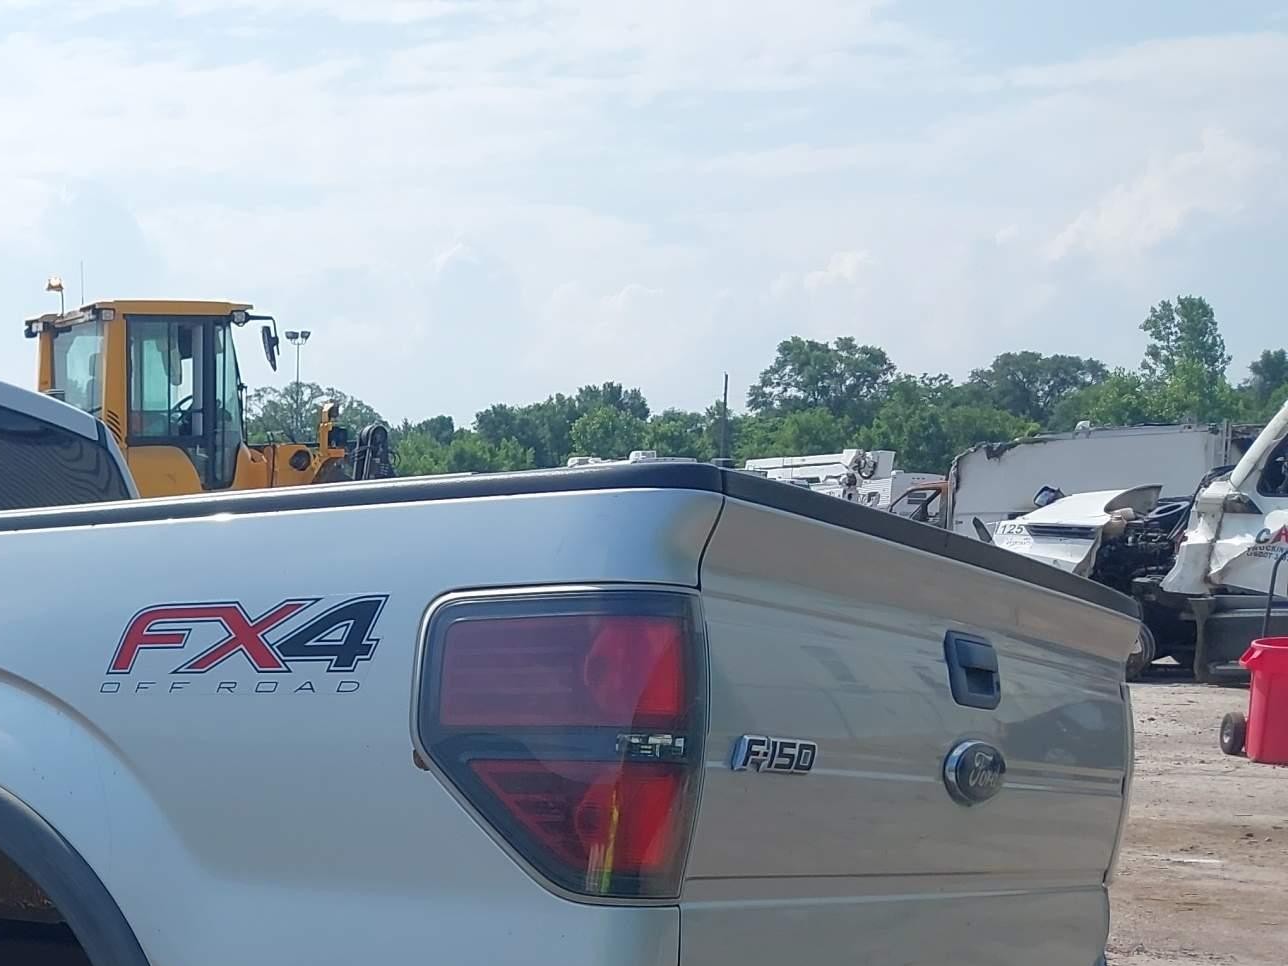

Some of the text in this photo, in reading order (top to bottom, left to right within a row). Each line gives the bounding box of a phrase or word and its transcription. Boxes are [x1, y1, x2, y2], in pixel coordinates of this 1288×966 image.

[1000, 523, 1025, 535] 125
[106, 594, 391, 675] FX4
[99, 680, 361, 694] OFF ROAD
[735, 735, 818, 774] F-150
[968, 751, 1000, 787] Ford
